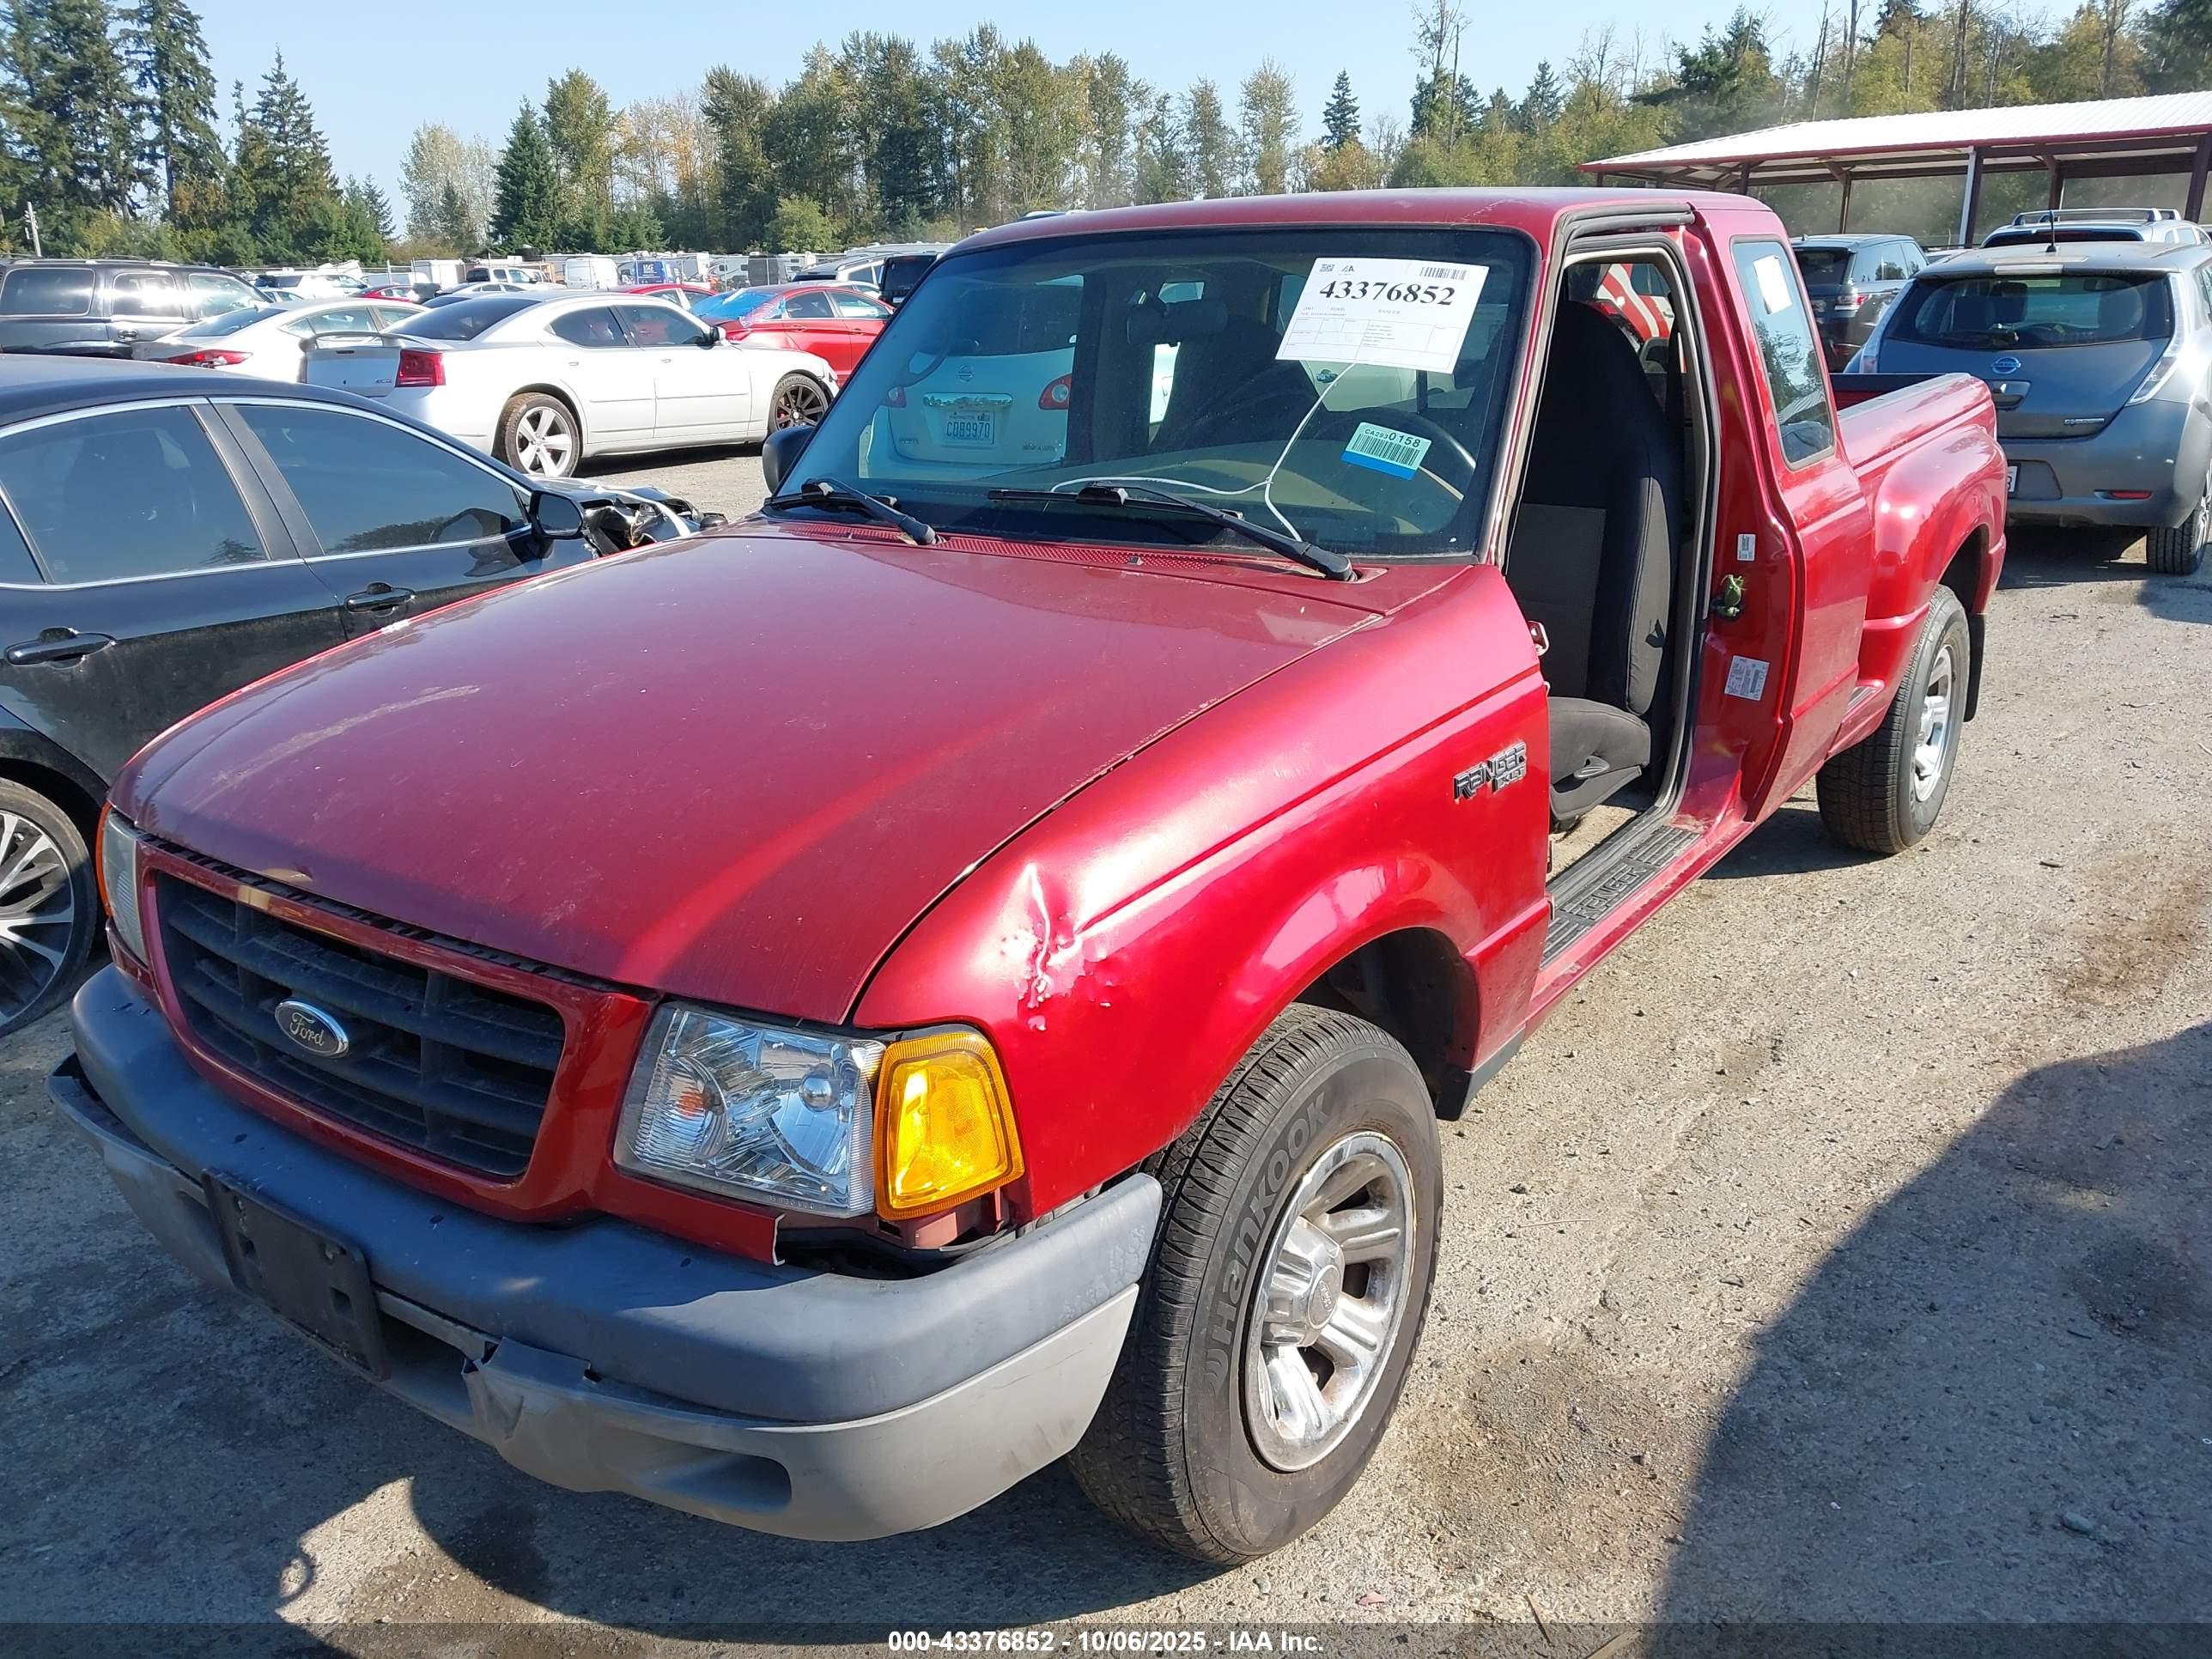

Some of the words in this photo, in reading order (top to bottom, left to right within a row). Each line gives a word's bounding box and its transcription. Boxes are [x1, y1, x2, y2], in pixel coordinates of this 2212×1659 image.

[1319, 280, 1455, 306] 43376852
[1453, 741, 1526, 800] RANGER
[1575, 866, 1647, 921] RANGER
[289, 1012, 326, 1046] Ford
